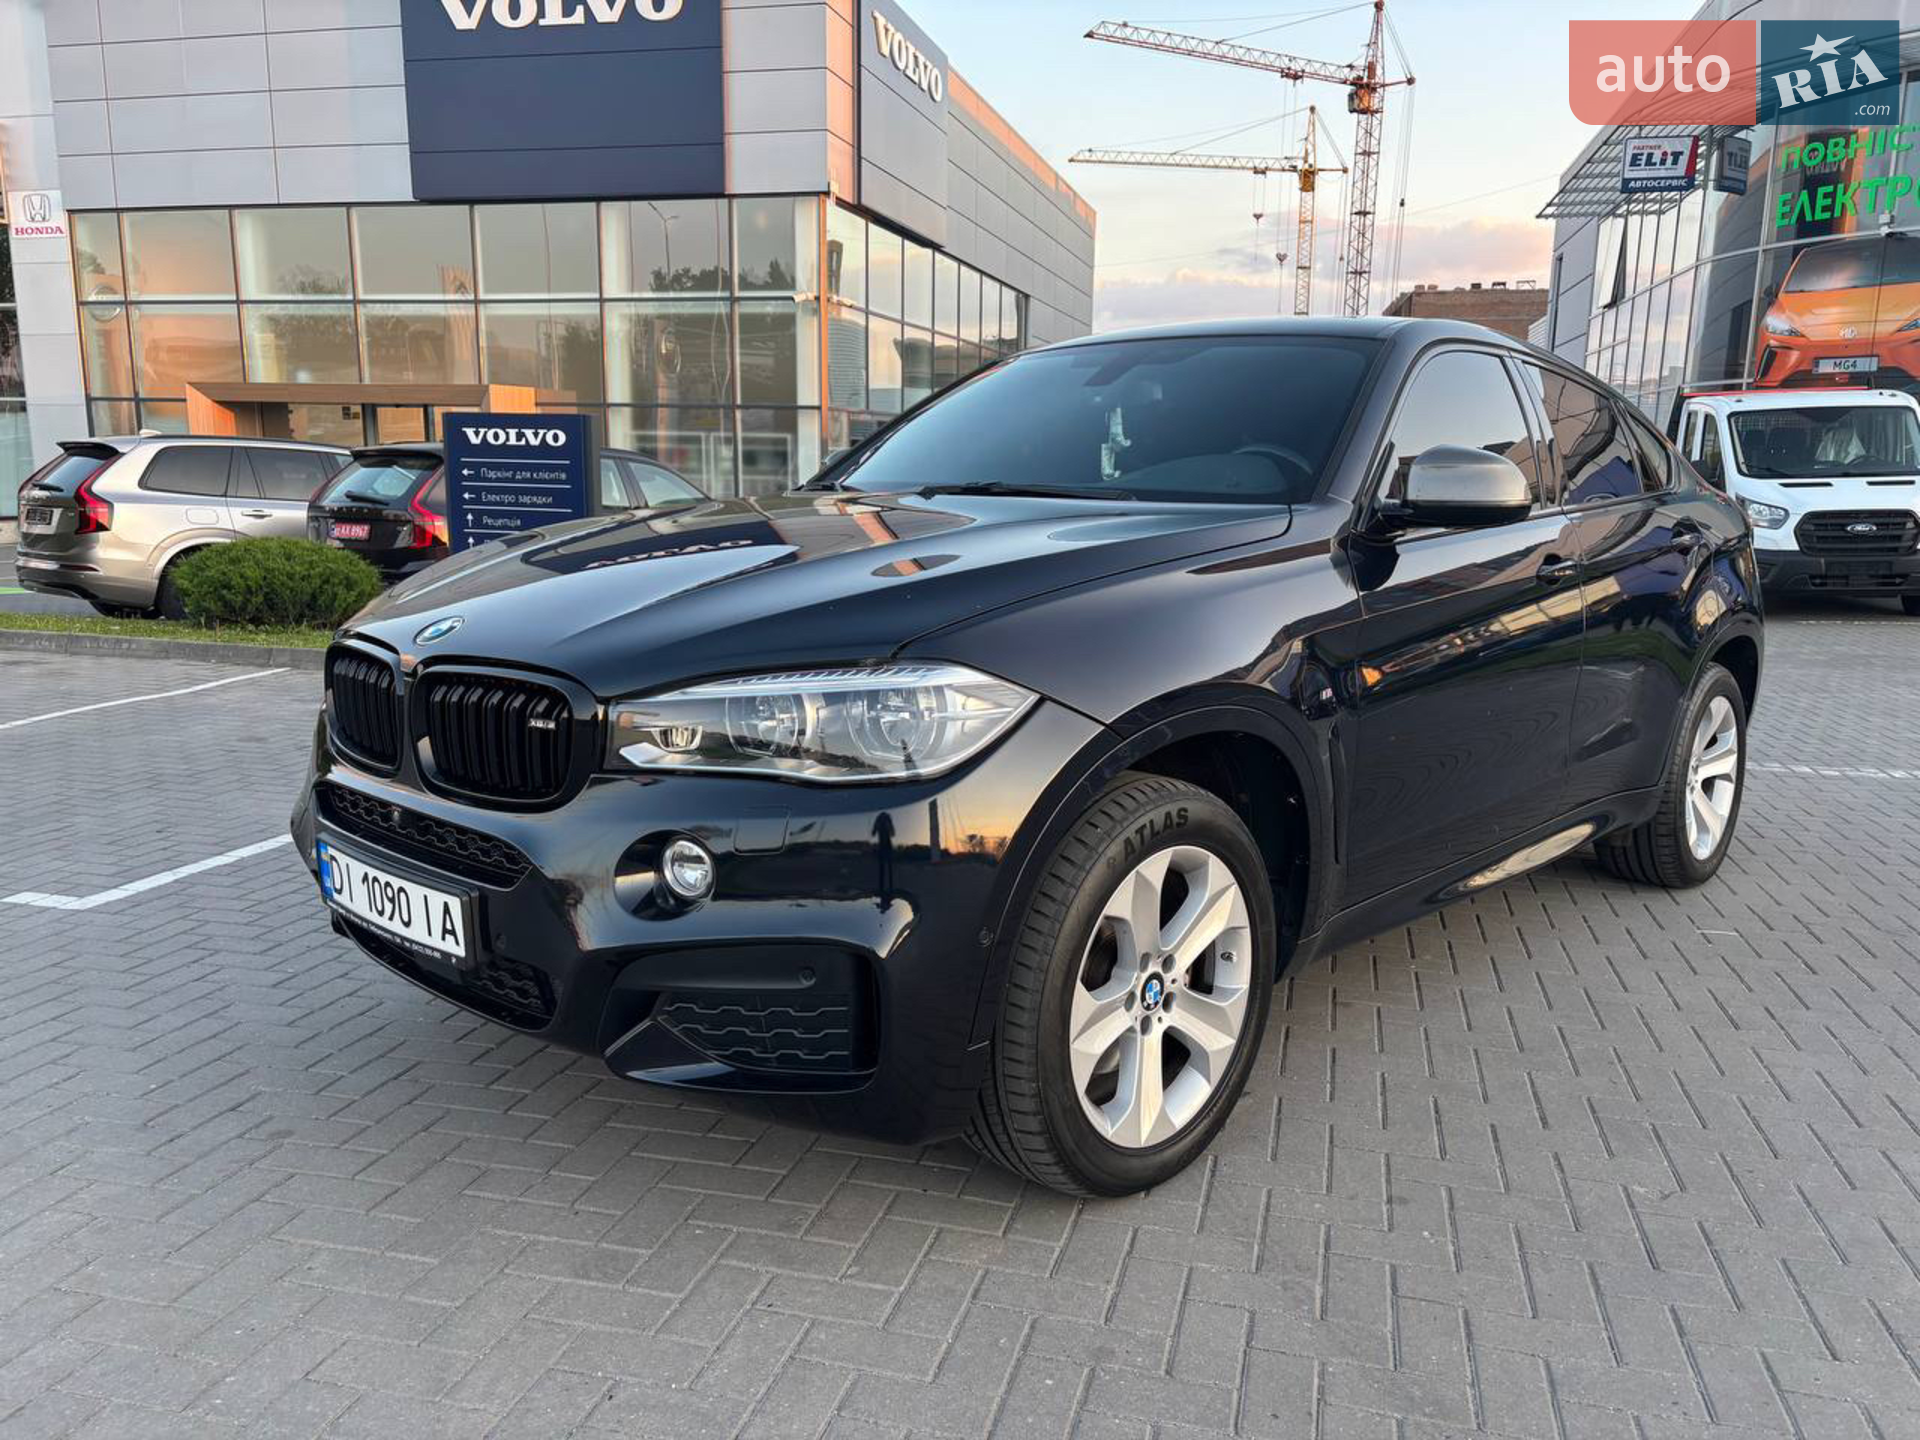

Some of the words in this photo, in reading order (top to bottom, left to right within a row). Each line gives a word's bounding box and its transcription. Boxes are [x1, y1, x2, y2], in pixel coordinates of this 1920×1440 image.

[871, 10, 942, 103] VOLVO
[1781, 122, 1920, 169] ПОВНІС
[1776, 173, 1920, 229] ЕЛЕКТР
[14, 225, 65, 236] HONDA
[1833, 359, 1858, 371] MG4
[462, 427, 567, 446] VOLVO
[480, 467, 512, 479] Паркінг
[515, 470, 531, 480] для
[482, 492, 516, 504] Електро
[518, 494, 553, 504] зарядки
[483, 516, 521, 527] Рецепція
[1123, 806, 1189, 863] ATLAS
[330, 854, 353, 903] DI
[361, 871, 412, 928] 1090
[423, 893, 460, 947] IA
